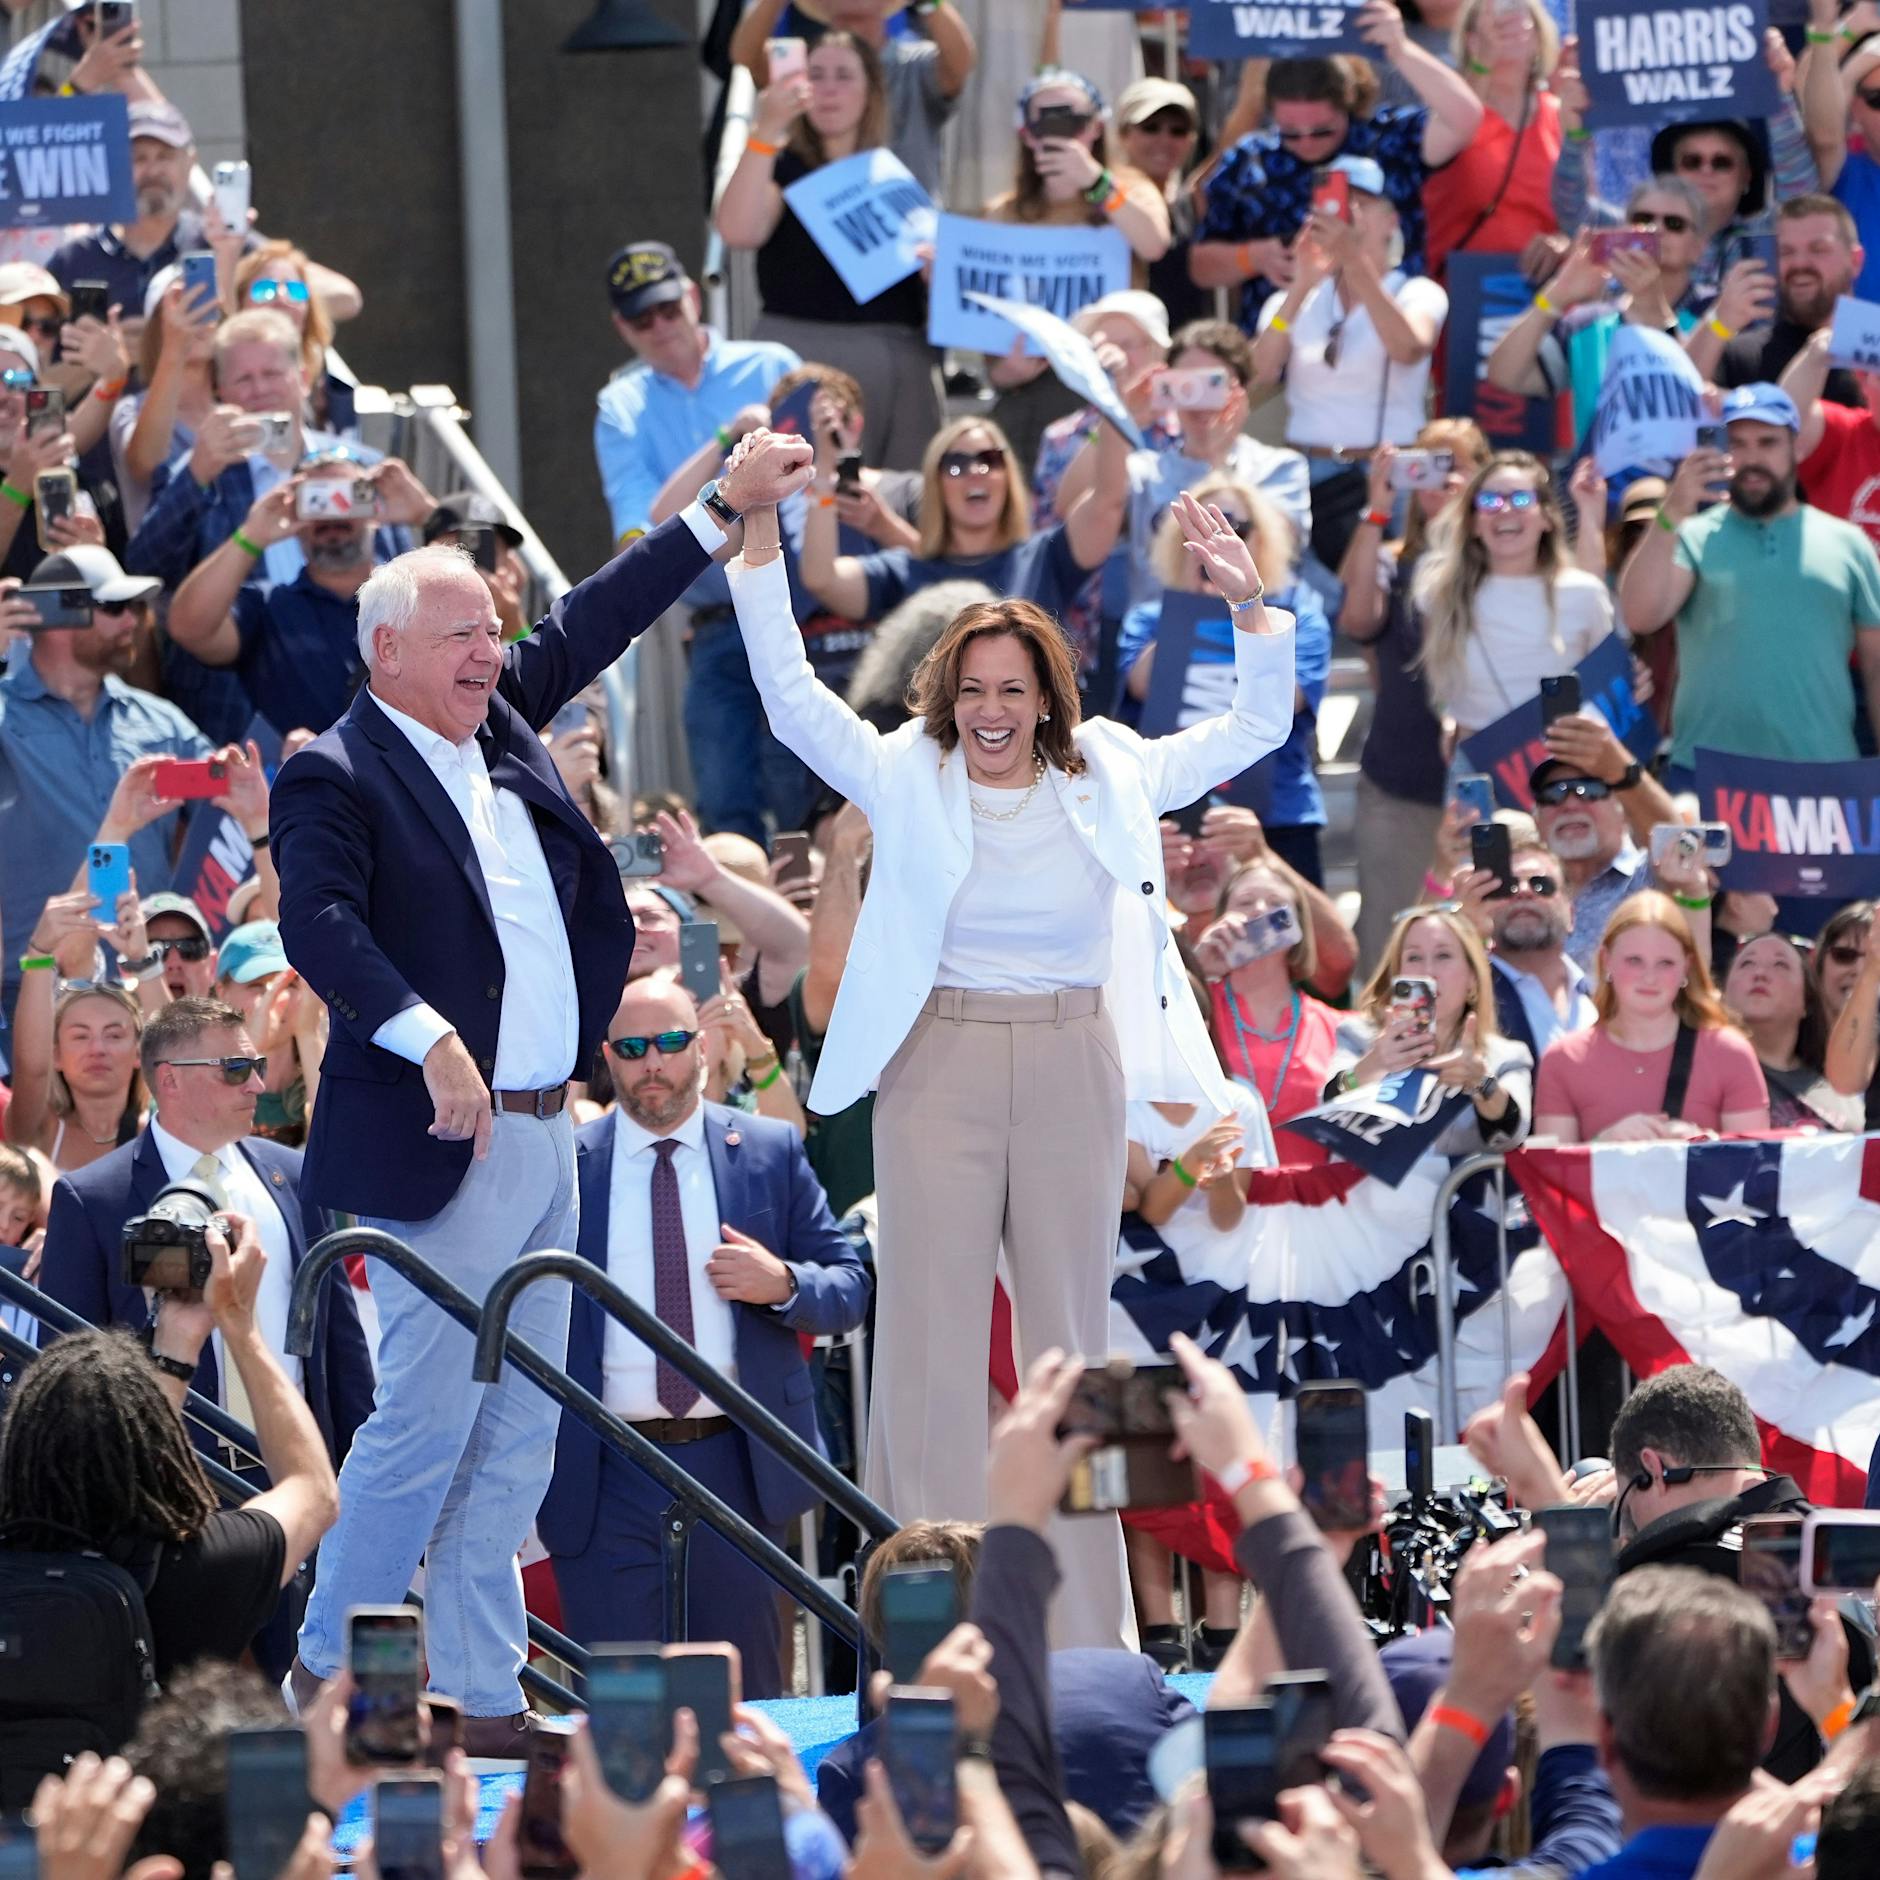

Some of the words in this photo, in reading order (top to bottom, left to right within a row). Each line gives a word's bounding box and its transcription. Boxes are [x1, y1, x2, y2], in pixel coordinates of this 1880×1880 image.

[1232, 6, 1345, 40] WALZ
[1594, 4, 1758, 74] HARRIS
[1622, 65, 1735, 105] WALZ
[5, 126, 39, 146] WE
[42, 121, 104, 144] FIGHT
[14, 144, 110, 200] WIN
[960, 245, 1015, 266] WHEN
[1018, 252, 1047, 268] WE
[1054, 253, 1101, 269] VOTE
[956, 264, 1011, 315] WE
[1022, 272, 1106, 320] WIN
[1619, 372, 1700, 421] WIN
[1714, 786, 1880, 856] KAMAL
